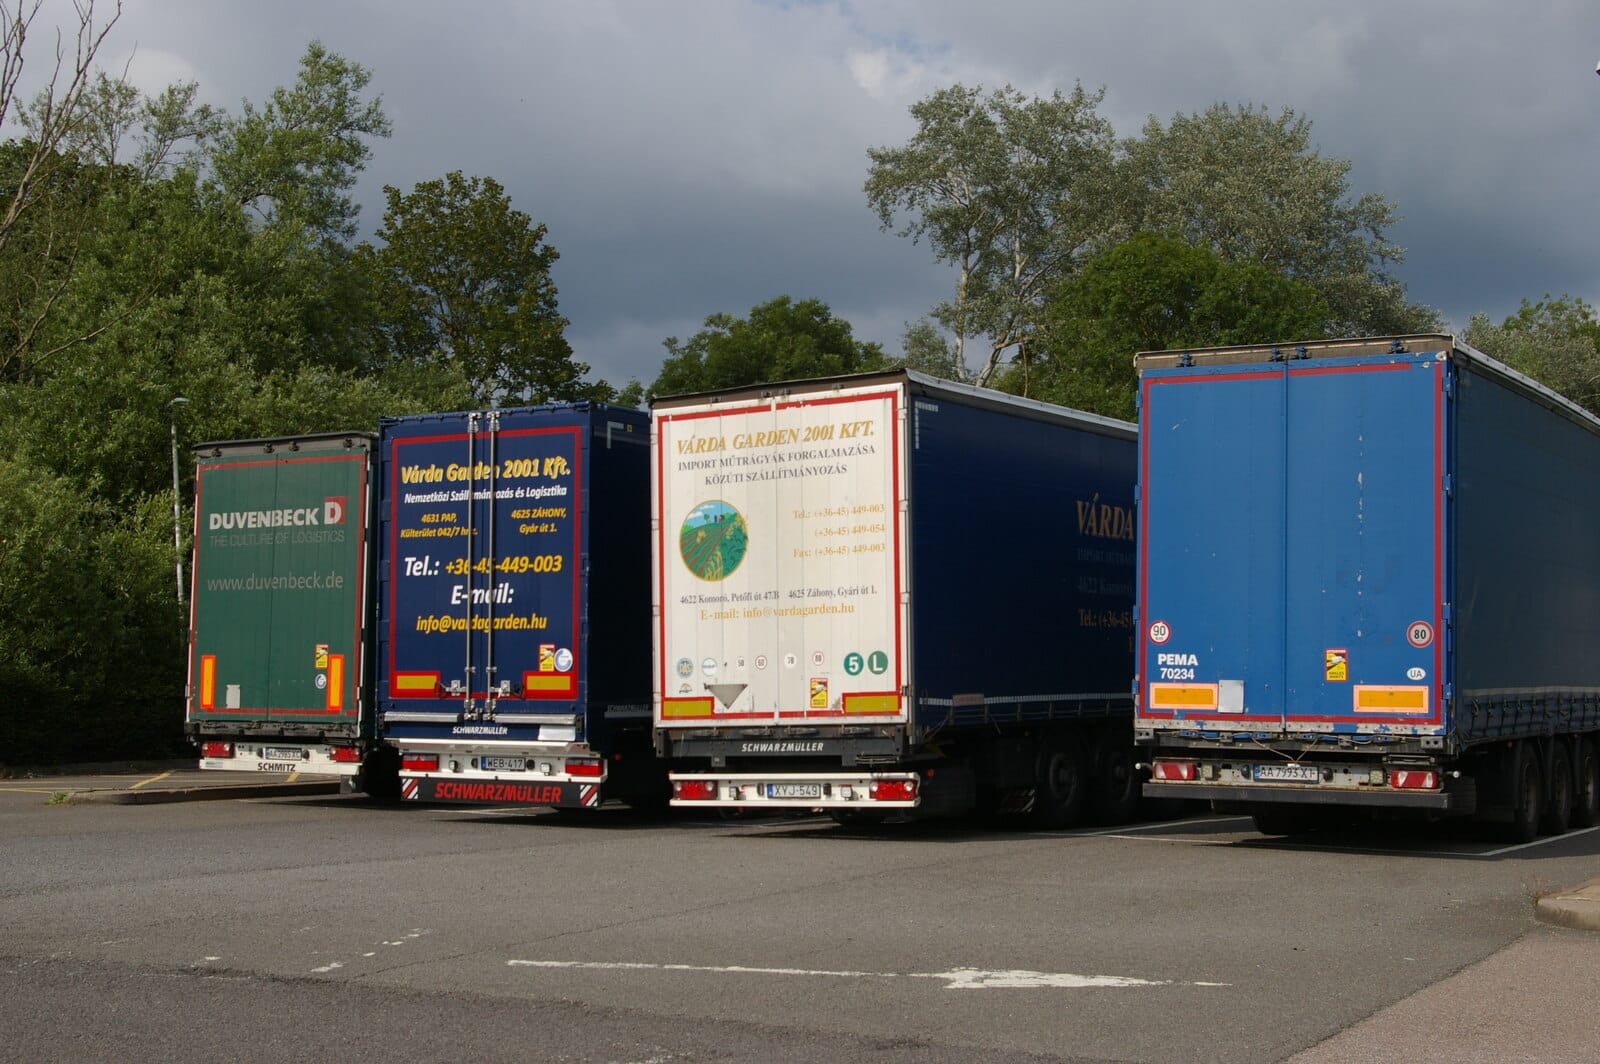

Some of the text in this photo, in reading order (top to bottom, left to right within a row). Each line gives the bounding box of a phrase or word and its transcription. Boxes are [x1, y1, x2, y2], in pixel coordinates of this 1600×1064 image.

[677, 420, 874, 455] VÁRDA GARDEN 2001 KFT.
[678, 459, 717, 471] IMPORT
[788, 445, 876, 462] FORGALMAZÁSA
[401, 463, 444, 484] Várda
[502, 458, 540, 478] 2001
[543, 456, 571, 480] Kft.
[705, 464, 848, 486] KÖZÚTI SZÁLLÍTMÁNYOZÁS
[404, 490, 449, 504] Nemzetközi
[515, 486, 525, 498] és
[526, 485, 568, 500] Logisztika
[209, 507, 320, 530] DUVENBECK
[421, 513, 439, 523] 4631
[511, 508, 530, 519] 4625
[1076, 492, 1134, 541] VÁRDA
[275, 532, 289, 544] OF
[291, 530, 345, 544] LOGISTICS
[404, 555, 440, 576] Tel.:
[207, 570, 344, 591] www.duvenbeck.de
[451, 582, 514, 605] E-mail:
[1153, 625, 1166, 637] 90
[1414, 629, 1426, 640] 80
[849, 656, 859, 674] 5
[873, 655, 883, 672] L
[1157, 653, 1198, 666] PEMA
[1160, 668, 1195, 680] 70234
[1410, 670, 1423, 678] UA
[452, 726, 508, 735] SCHWARZMÜLLER
[741, 742, 824, 752] SCHWARZMÜLLER
[257, 762, 296, 772] SCHMITZ
[1260, 766, 1273, 777] AA
[434, 782, 562, 803] SCHWARZMÜLLER
